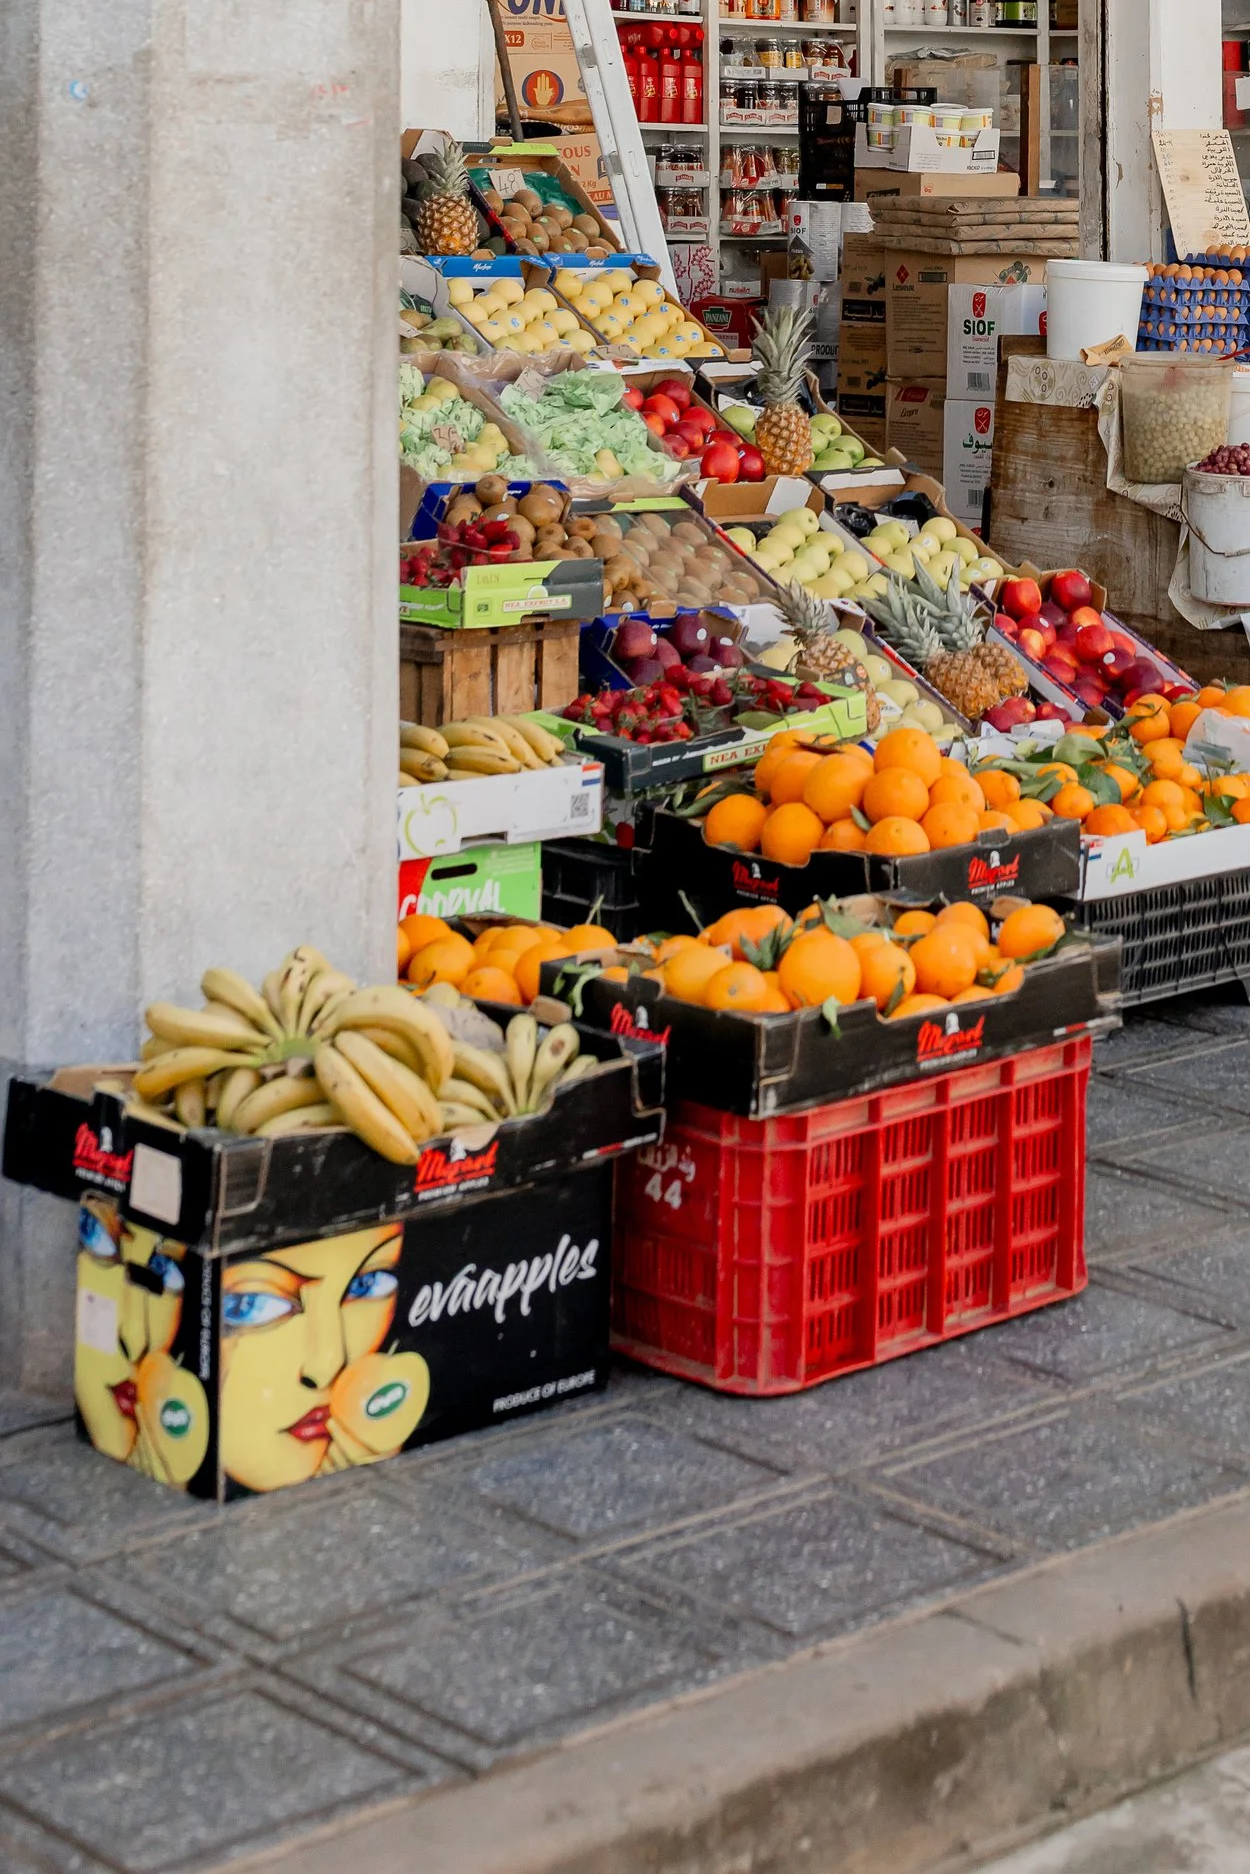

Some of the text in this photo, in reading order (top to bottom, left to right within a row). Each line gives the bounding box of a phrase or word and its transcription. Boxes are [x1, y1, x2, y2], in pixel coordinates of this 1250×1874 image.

[790, 227, 806, 235] SIOF
[705, 312, 729, 322] PANZANI
[963, 319, 995, 335] SIOF
[710, 749, 738, 765] NEA
[917, 1015, 986, 1059] Mozart
[415, 1140, 499, 1189] Mozart
[644, 1172, 682, 1210] 44
[493, 1369, 596, 1413] PRODUCE OF EUROPE
